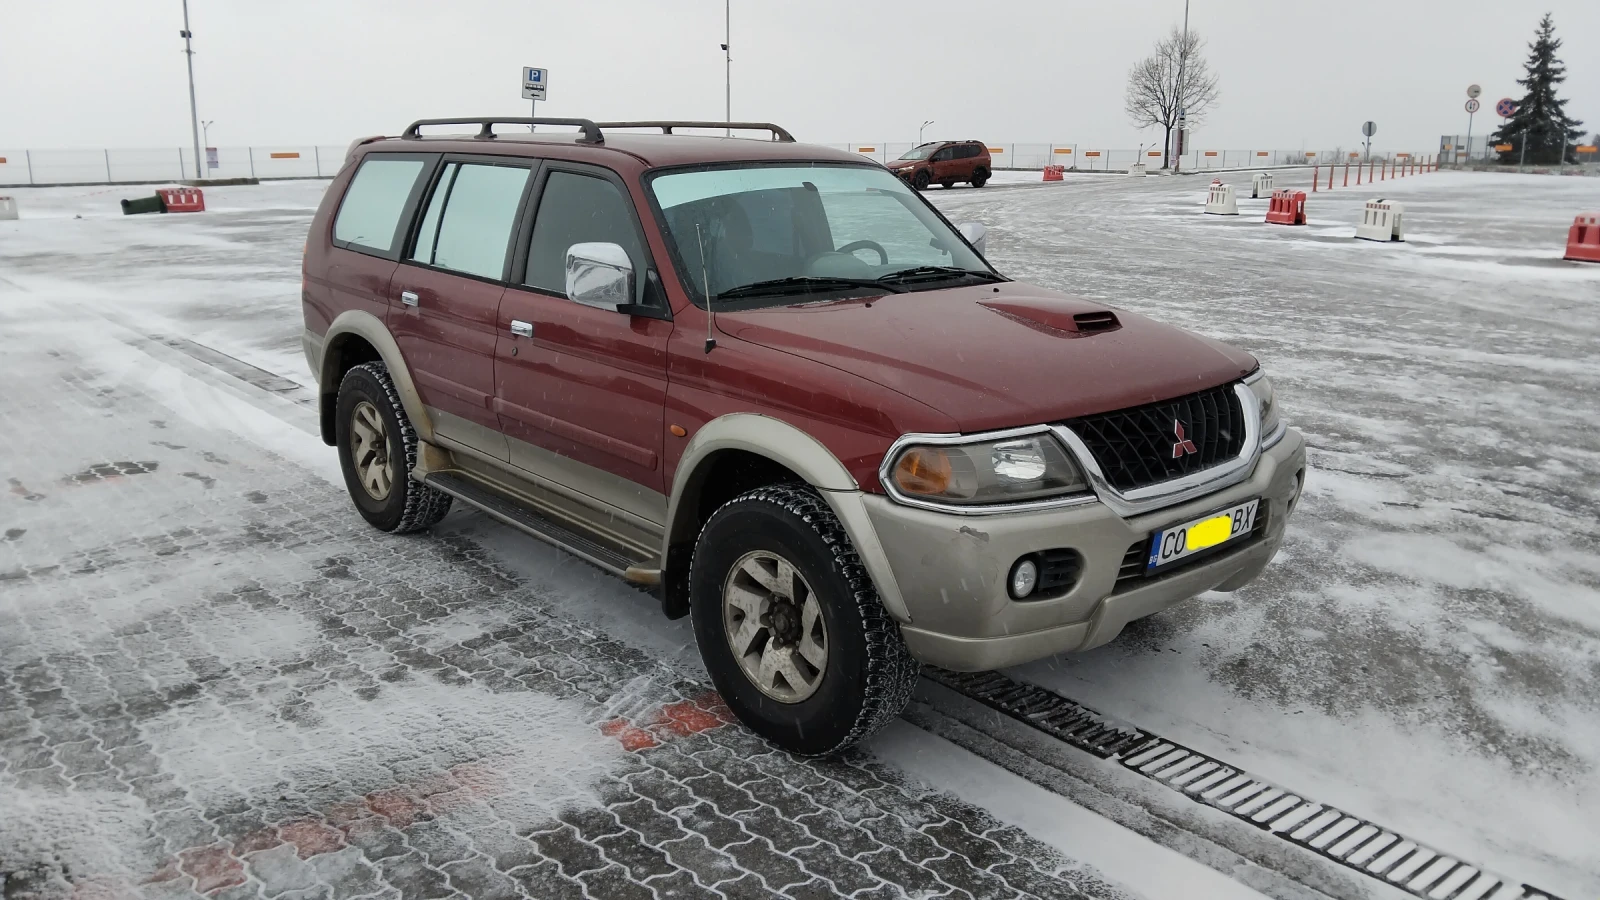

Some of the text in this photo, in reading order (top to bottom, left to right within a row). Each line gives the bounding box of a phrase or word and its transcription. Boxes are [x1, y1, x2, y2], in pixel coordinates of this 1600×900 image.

[531, 70, 539, 80] P
[1162, 504, 1255, 559] CO BX
